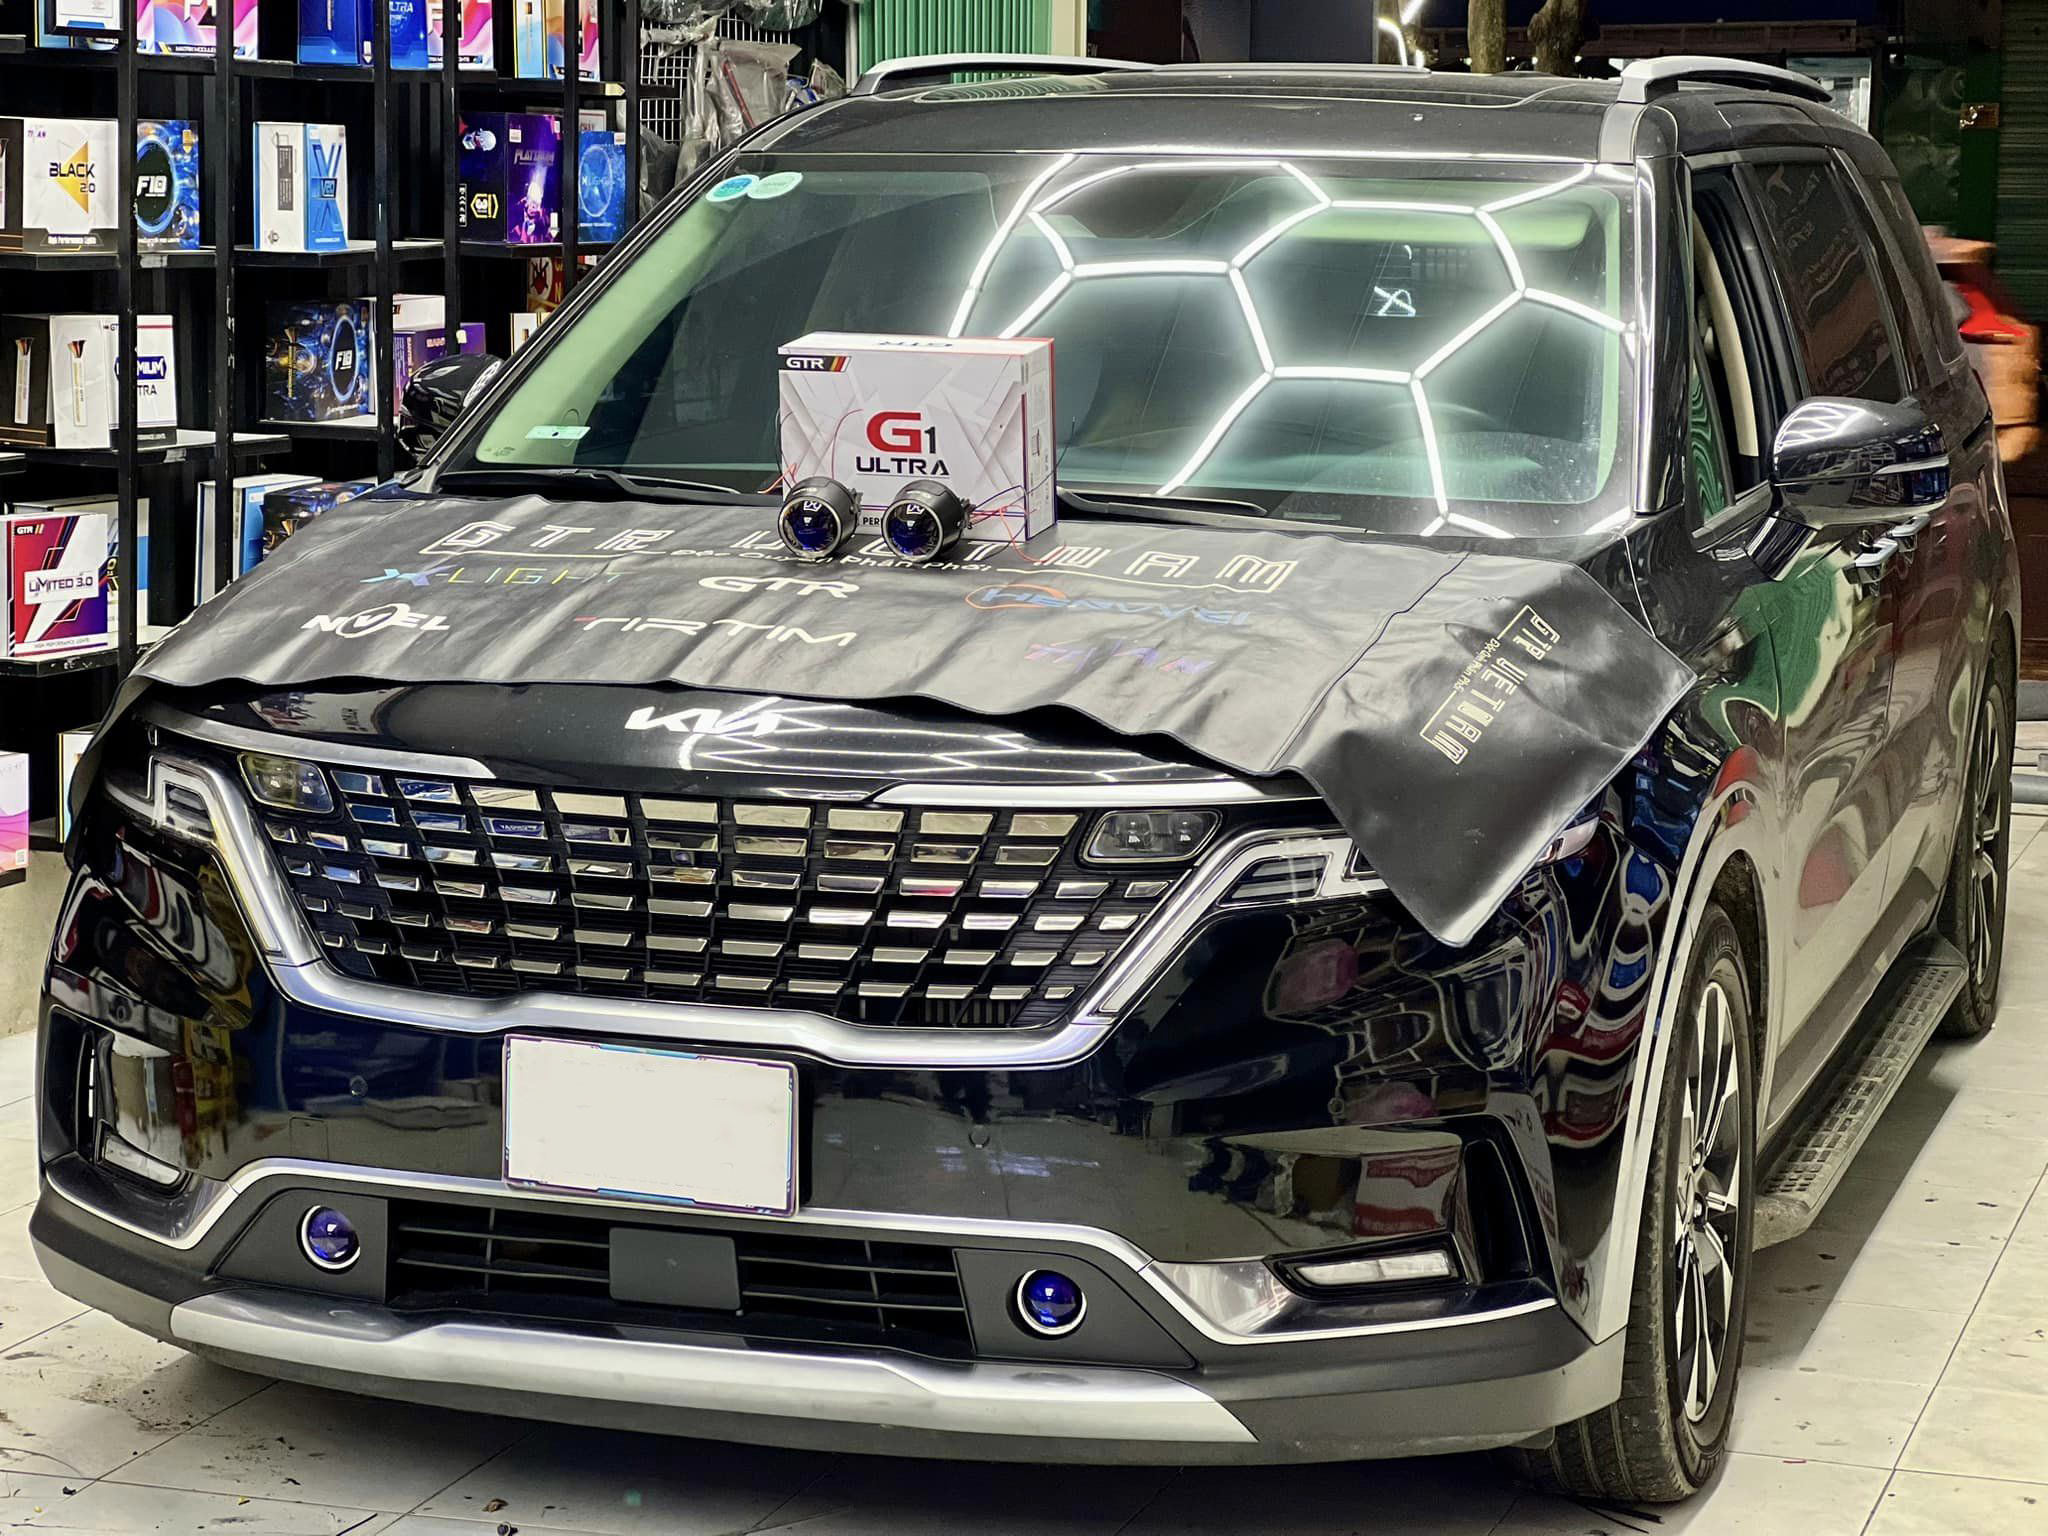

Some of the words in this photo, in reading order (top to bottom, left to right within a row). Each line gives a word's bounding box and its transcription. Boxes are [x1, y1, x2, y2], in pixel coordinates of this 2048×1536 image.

[390, 1, 414, 13] LTRA
[49, 162, 95, 178] BLACK
[80, 182, 96, 193] 2.0
[786, 357, 825, 369] GTR
[137, 384, 158, 396] TRA
[866, 411, 937, 454] G1
[856, 456, 950, 476] ULTRA
[16, 525, 34, 535] GTR
[28, 576, 74, 594] LIMITED
[75, 576, 94, 588] 3.0
[698, 576, 860, 598] GTR
